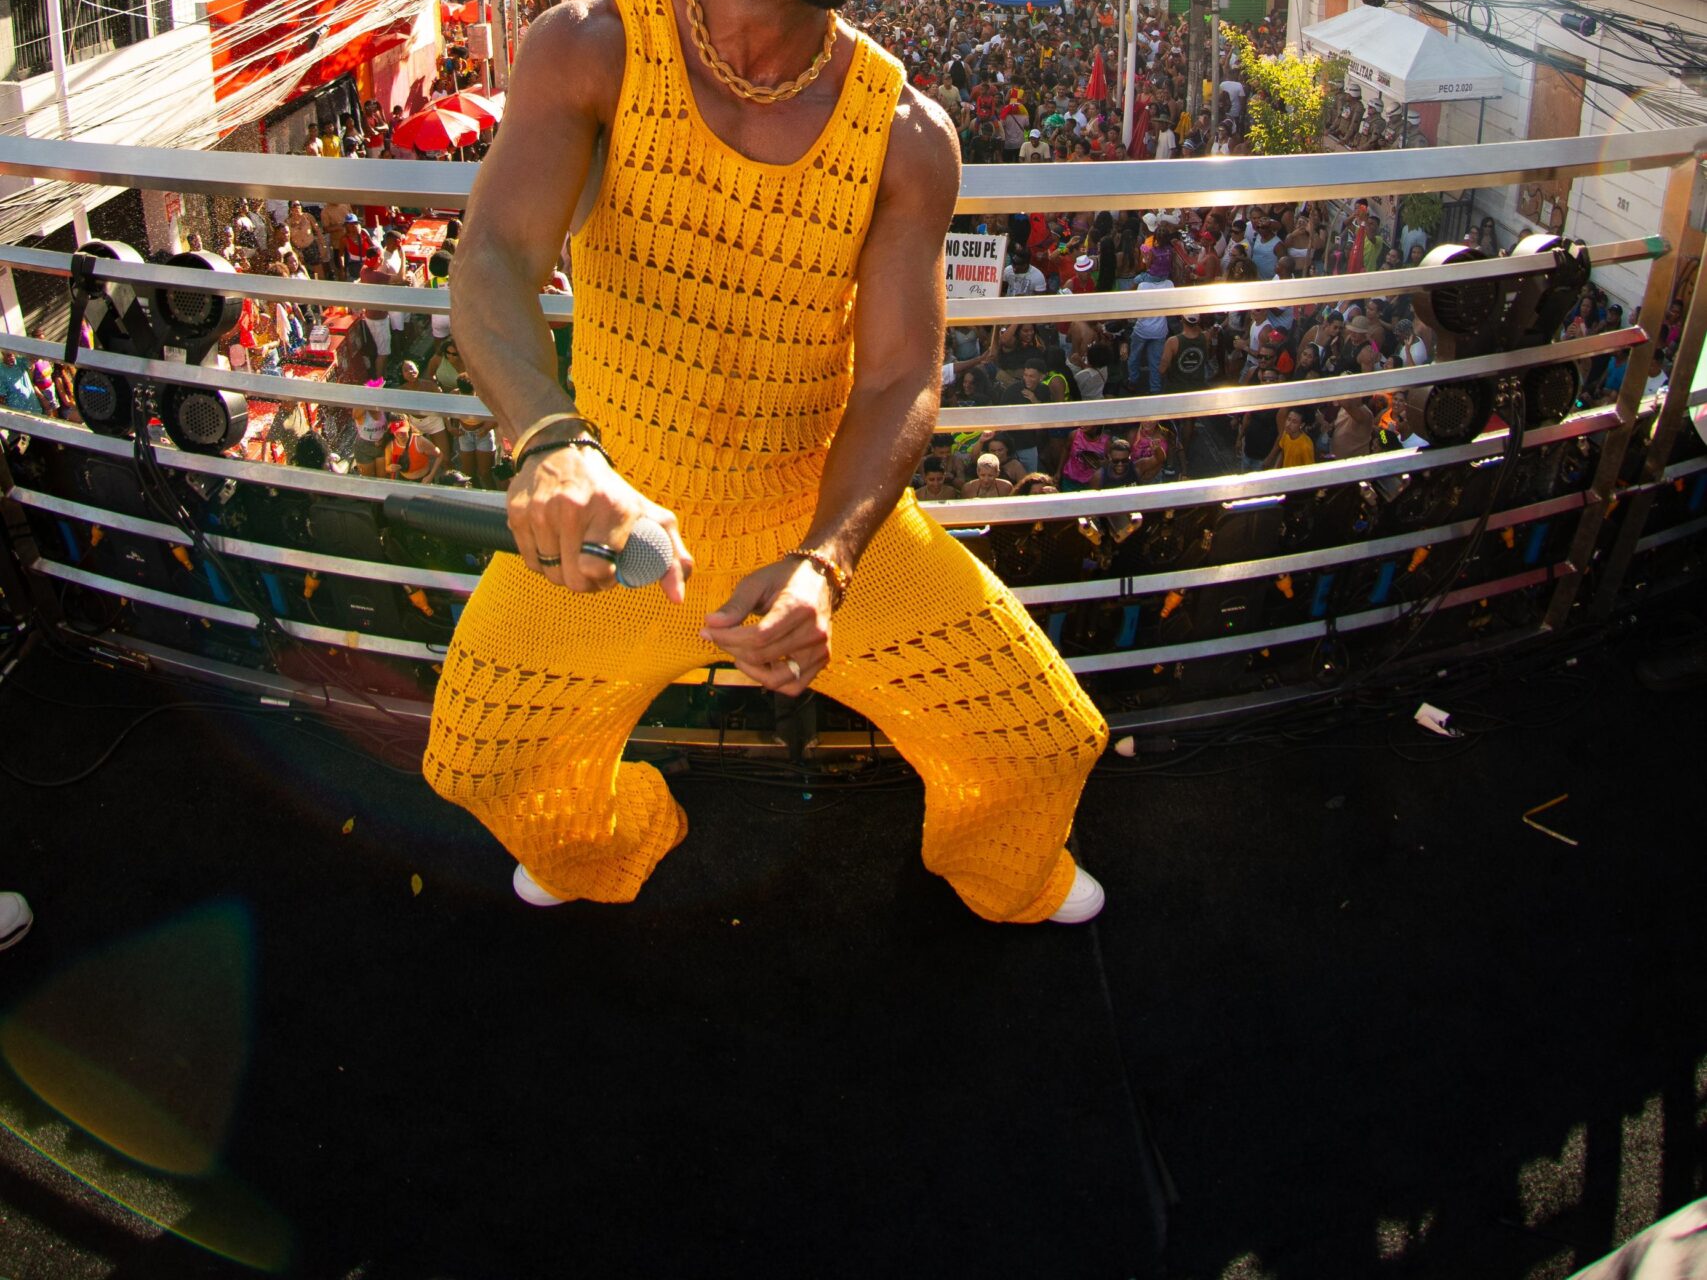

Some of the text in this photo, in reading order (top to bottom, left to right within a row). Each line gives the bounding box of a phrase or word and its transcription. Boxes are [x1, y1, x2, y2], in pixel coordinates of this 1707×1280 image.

[962, 240, 982, 258] SEU
[984, 239, 997, 260] PÉ,
[955, 264, 998, 283] MULHER.
